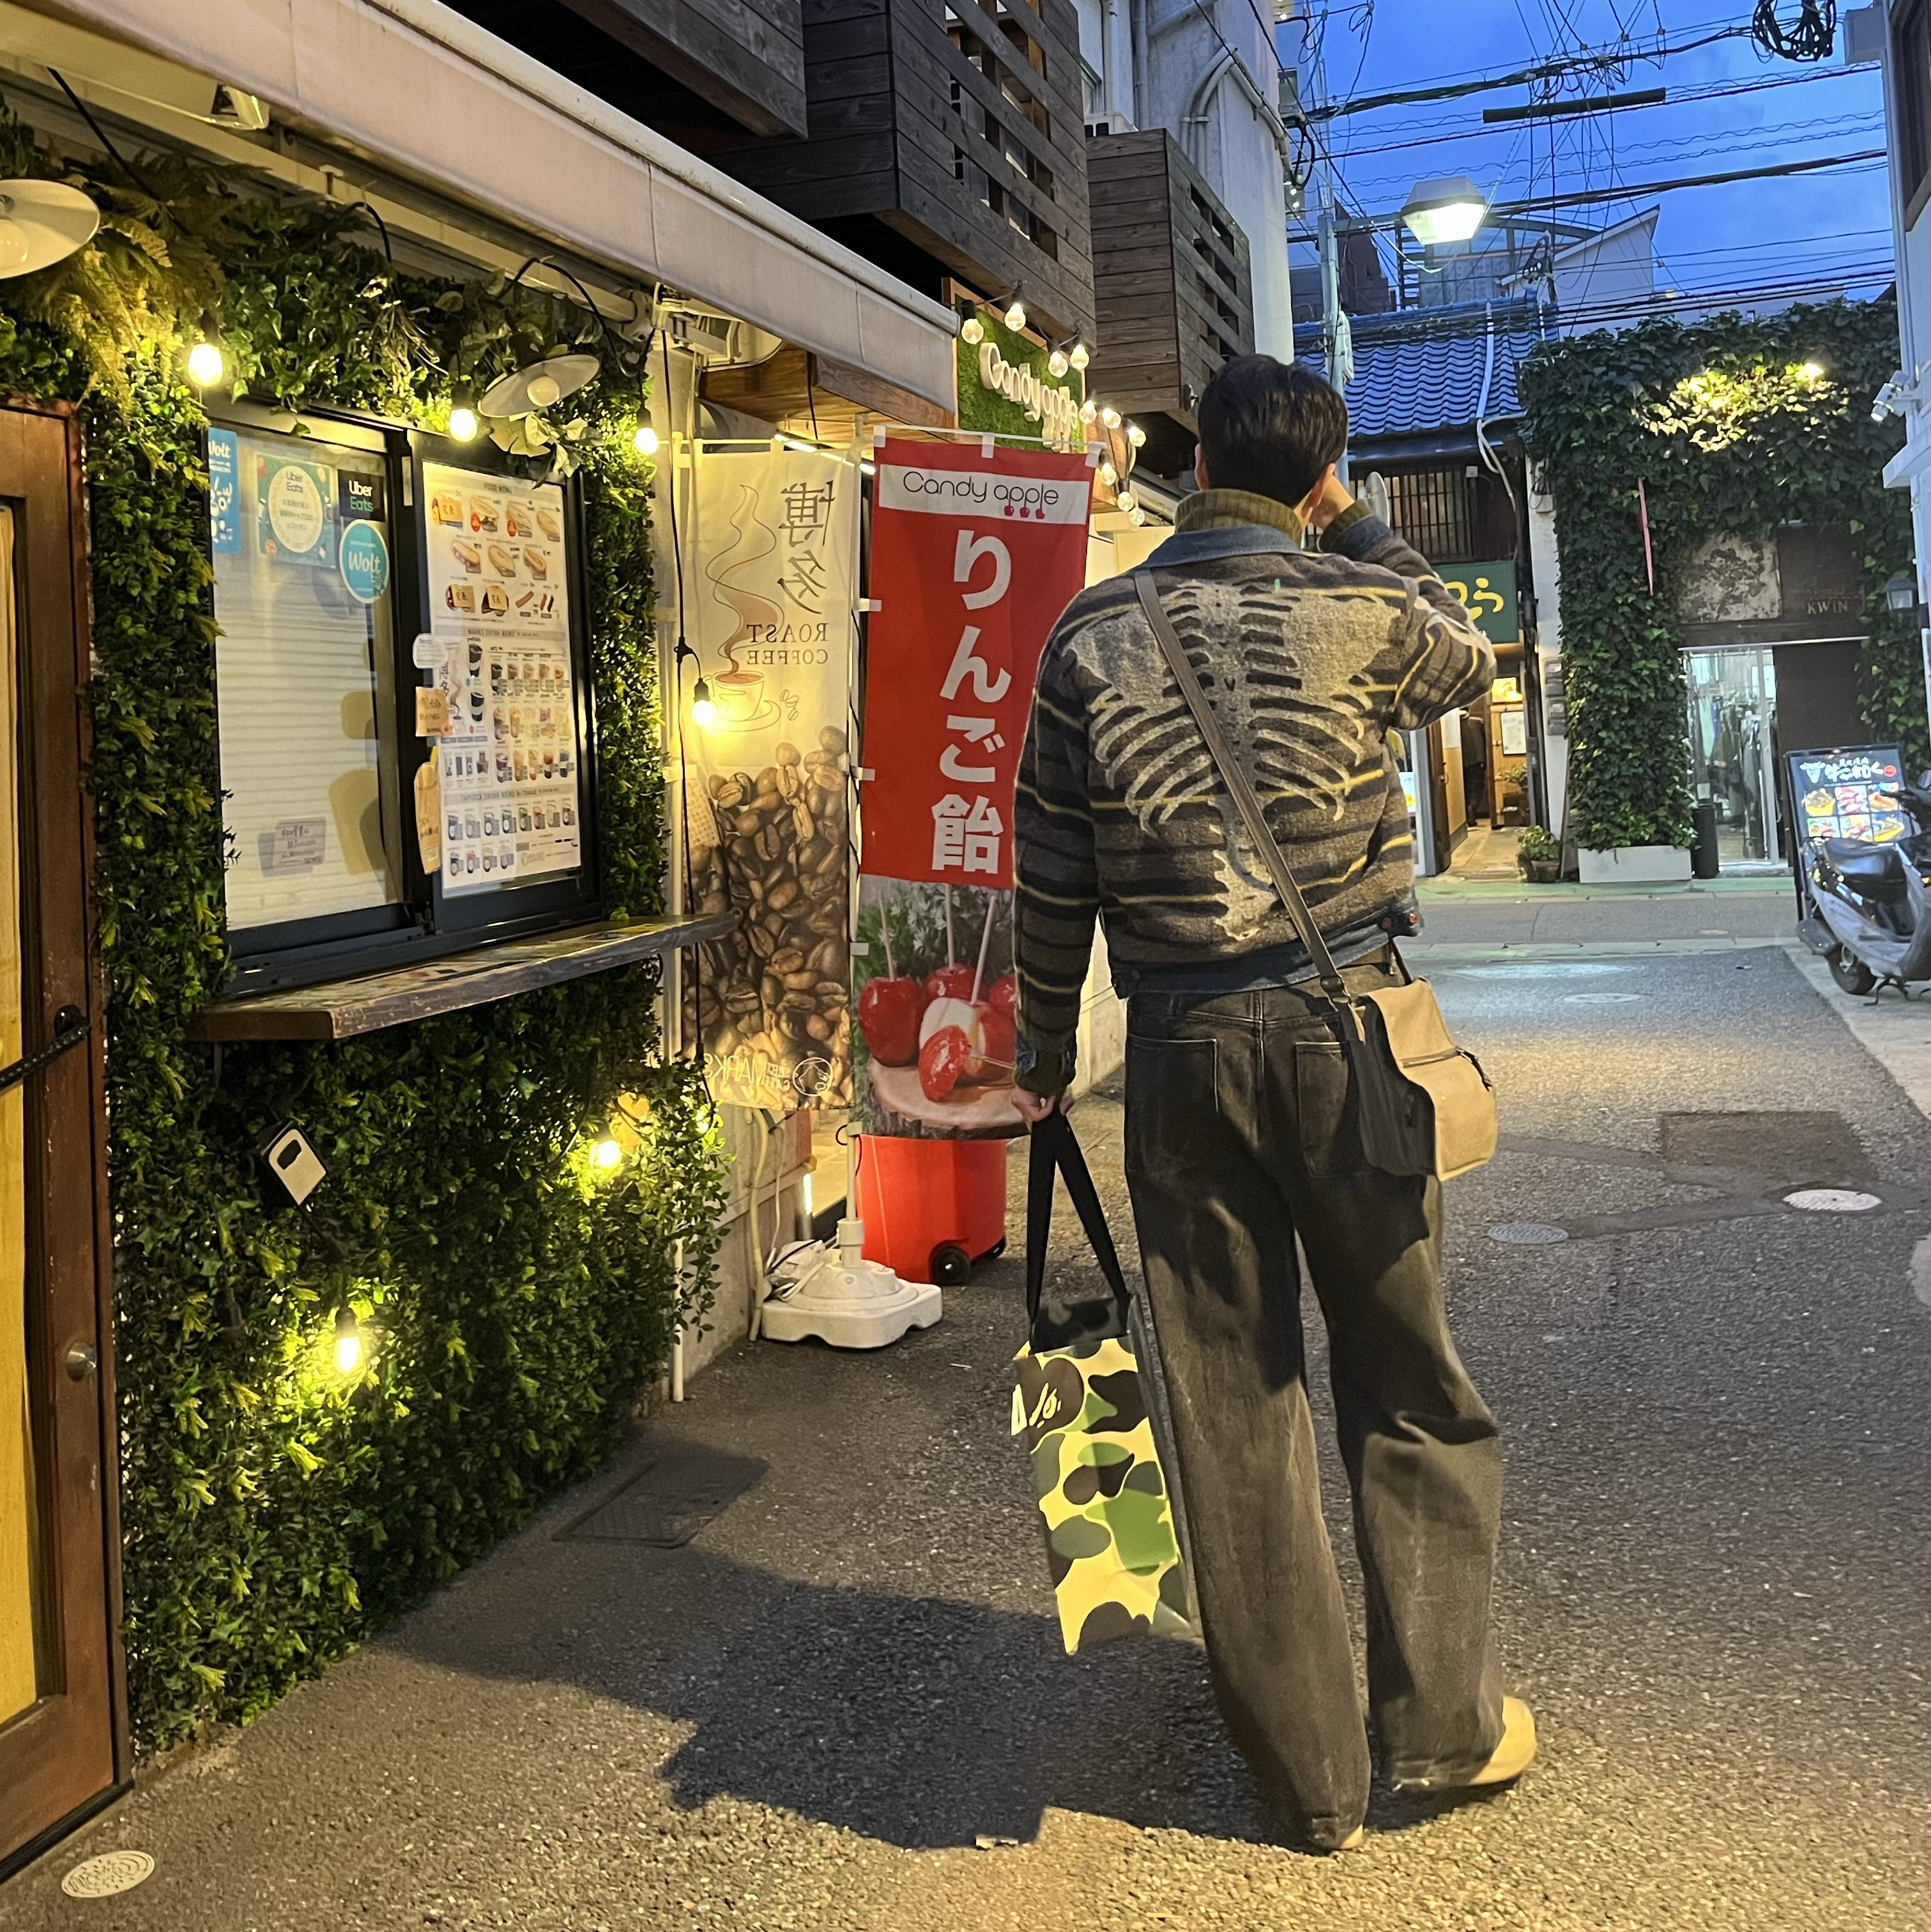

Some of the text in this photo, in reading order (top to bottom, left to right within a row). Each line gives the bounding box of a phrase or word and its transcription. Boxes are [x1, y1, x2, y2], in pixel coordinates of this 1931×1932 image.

[979, 342, 1079, 454] Candy apple
[286, 470, 303, 482] Uber
[286, 481, 303, 493] Eats
[349, 480, 373, 497] Uber
[903, 471, 1059, 511] Candy apple
[350, 496, 374, 512] Eats
[348, 551, 381, 574] Wolt
[931, 529, 1012, 874] りんご飴
